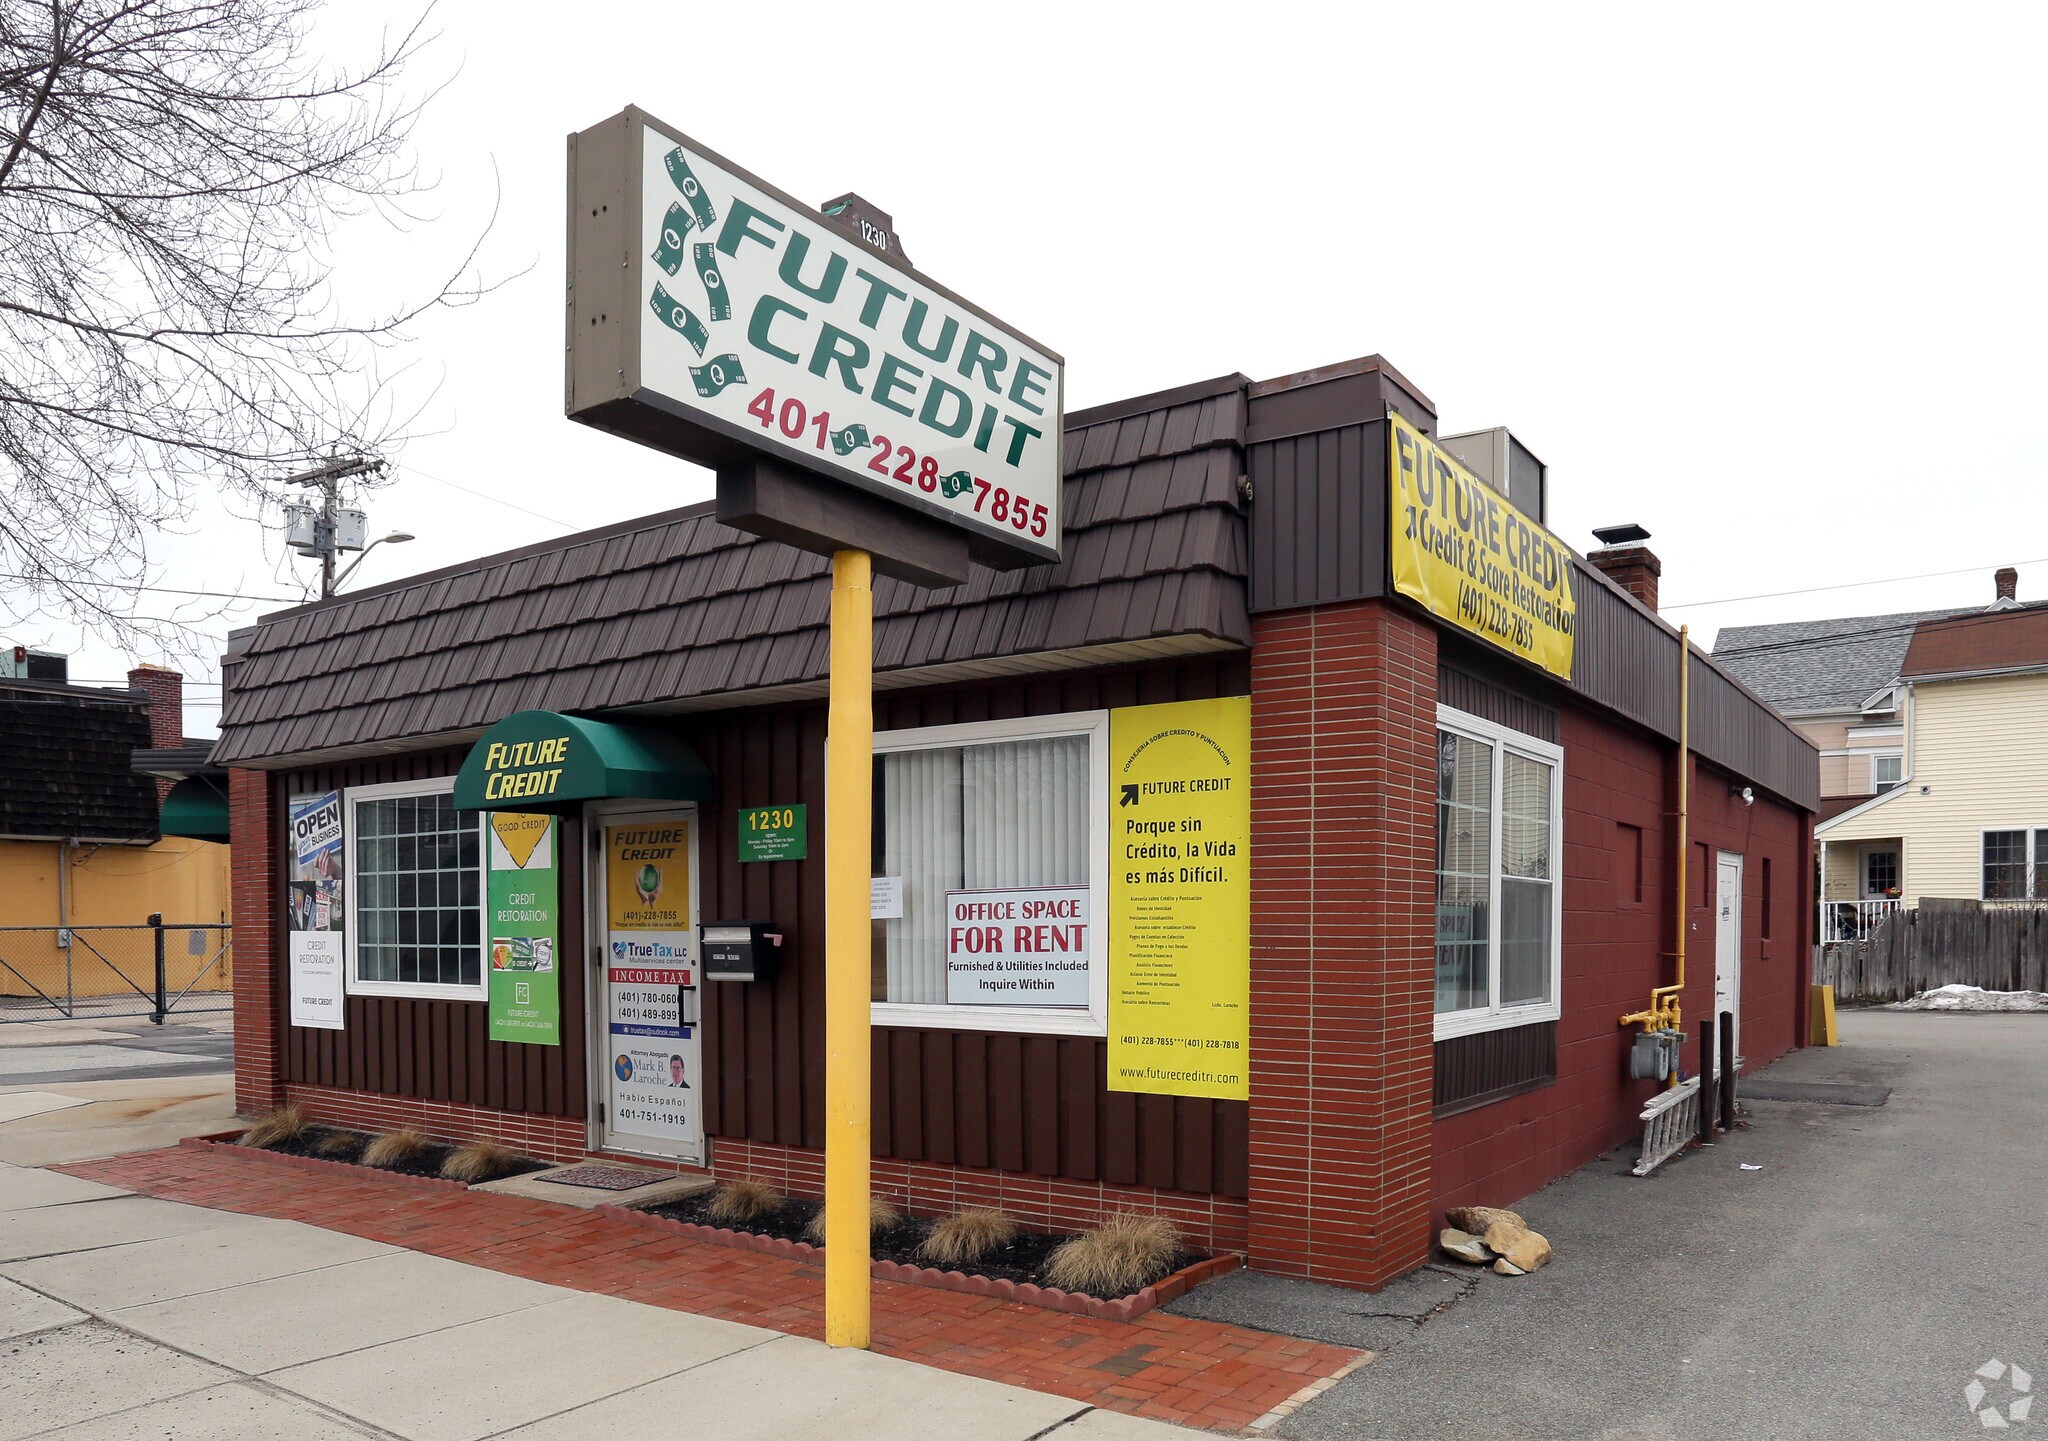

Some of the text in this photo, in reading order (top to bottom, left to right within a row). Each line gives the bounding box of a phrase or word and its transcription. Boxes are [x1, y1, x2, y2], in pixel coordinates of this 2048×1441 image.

[676, 148, 685, 163] 100
[665, 156, 674, 172] 100
[670, 201, 680, 214] 100
[707, 205, 717, 220] 100
[684, 217, 695, 229] 100
[697, 214, 706, 230] 100
[861, 219, 886, 251] 1230
[653, 249, 663, 261] 100
[667, 262, 677, 275] 100
[656, 283, 667, 298] 100
[651, 299, 662, 313] 100
[715, 195, 1053, 416] FUTURE
[698, 324, 708, 338] 100
[692, 340, 703, 354] 100
[728, 354, 738, 362] 100
[691, 368, 701, 376] 100
[747, 293, 1042, 469] CREDIT
[747, 387, 1049, 538] 401 228 7855
[1396, 426, 1500, 555] FUTURE
[1420, 508, 1576, 637] Credit & Score Restoration
[1457, 580, 1533, 652] (401) 228-7855
[485, 737, 570, 771] FUTURE
[1123, 741, 1150, 772] CONSEJERIA
[1149, 731, 1169, 743] SOBRE
[1200, 734, 1231, 766] PUNTUACION
[485, 768, 563, 800] CREDIT
[1142, 778, 1231, 795] FUTURE CREDIT
[296, 802, 338, 839] OPEN
[497, 820, 545, 832] GOOD CREDIT
[748, 809, 793, 830] 1230
[1126, 816, 1202, 837] Porque sin
[311, 824, 340, 846] BUSINESS
[614, 829, 684, 846] FUTURE
[621, 848, 676, 861] CREDIT
[1126, 841, 1236, 860] Crédito, la Vida
[1126, 866, 1228, 884] es más Difícil.
[508, 893, 535, 905] CREDIT
[497, 910, 547, 922] RESTORATION
[623, 910, 677, 921] (401)-228-7855
[955, 899, 1081, 921] OFFICE SPACE
[951, 924, 1087, 953] FOR RENT
[628, 942, 687, 957] TrueTax LLC
[949, 960, 1089, 971] Furnished & Utilities Included
[615, 970, 684, 983] INCOME TAX
[979, 979, 1055, 992] Inquire Within
[618, 992, 639, 1004] (401)
[618, 1008, 680, 1020] (401) 489-899
[1120, 1035, 1139, 1046] (401)
[1206, 1040, 1240, 1049] 228-7818
[633, 1059, 666, 1072] Mark B.
[634, 1072, 667, 1085] Laroche
[1120, 1067, 1239, 1084] www.futurecreditri.com
[620, 1092, 686, 1106] Hablo Español
[620, 1109, 685, 1125] 401-751-1919
